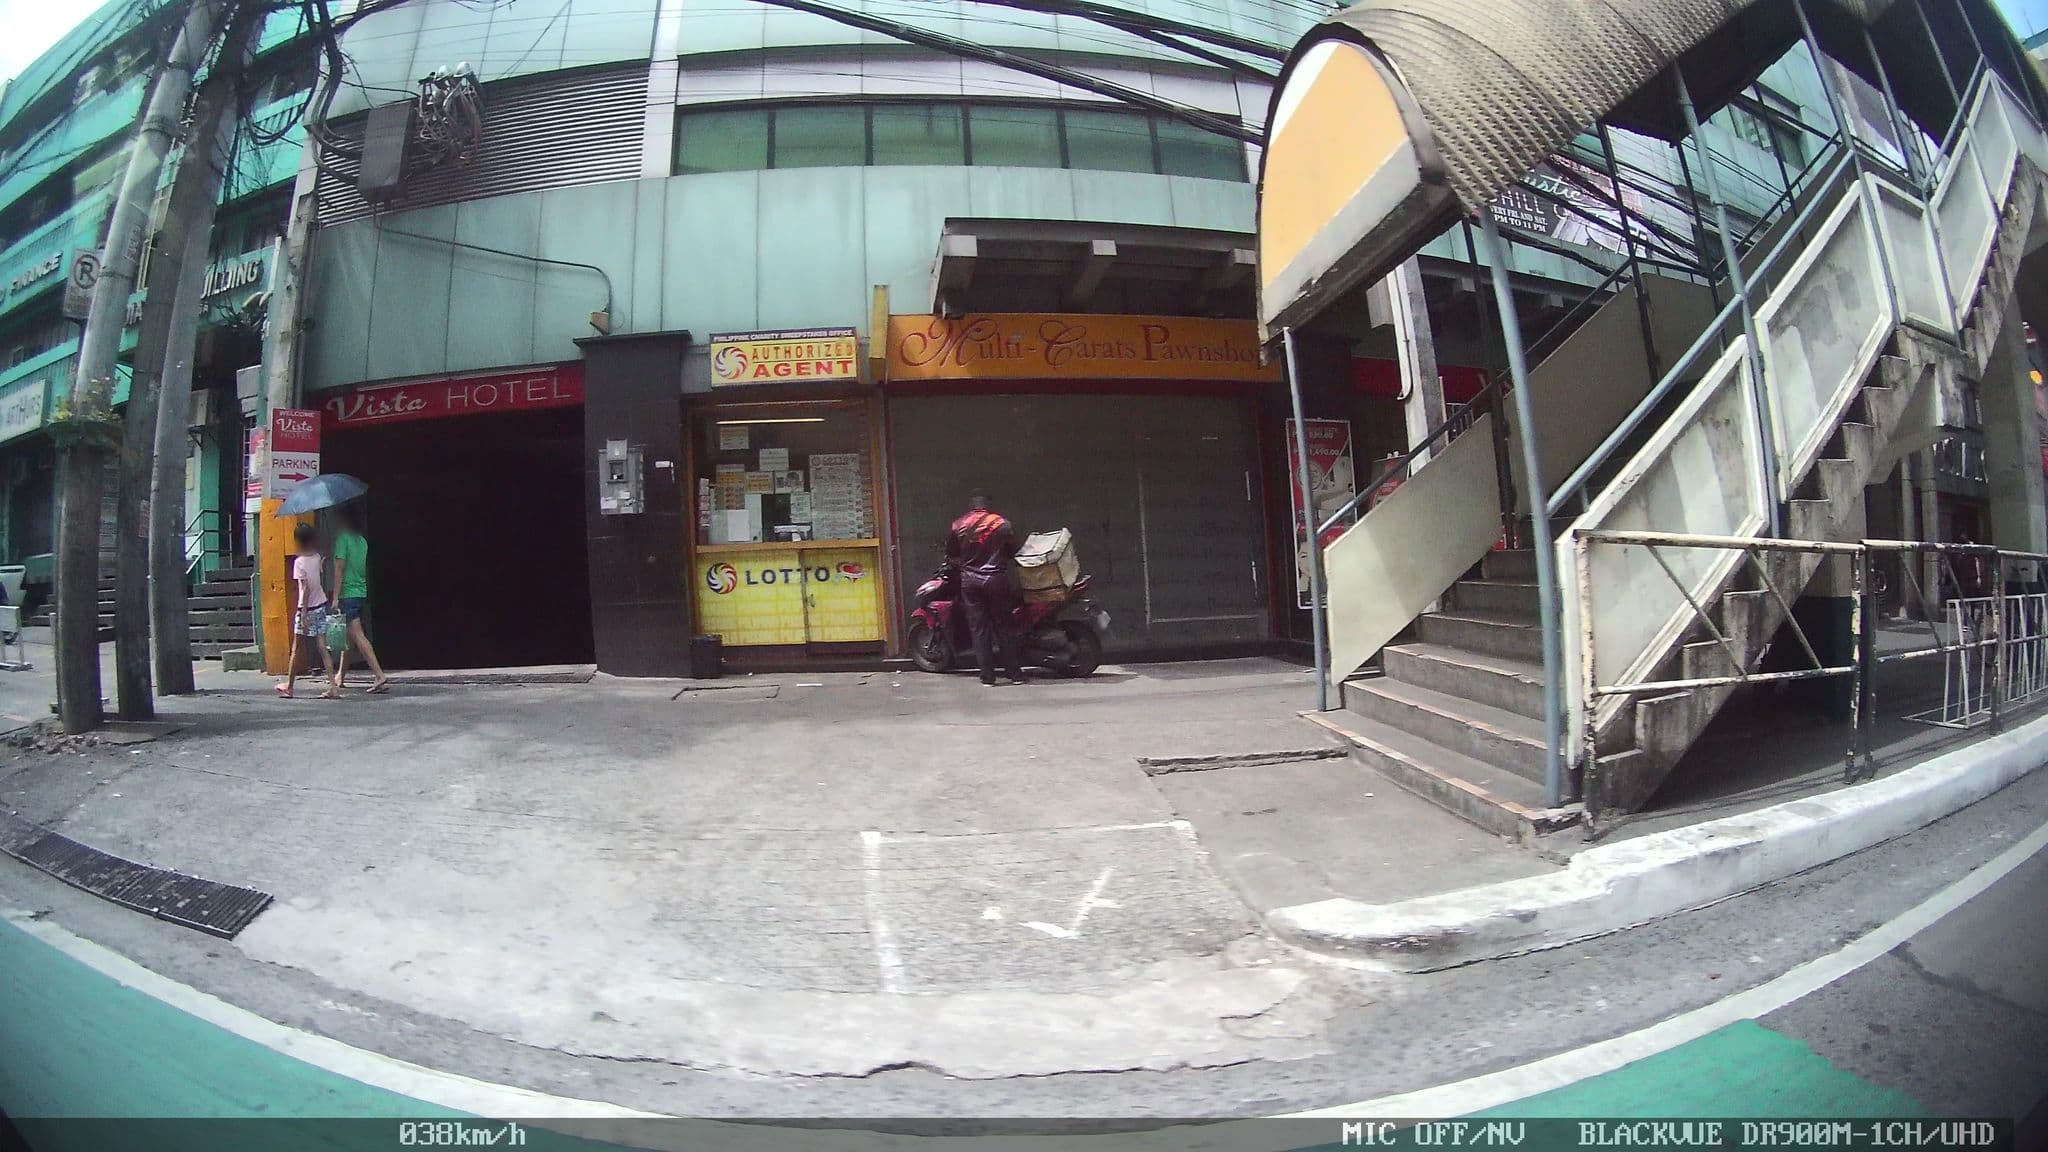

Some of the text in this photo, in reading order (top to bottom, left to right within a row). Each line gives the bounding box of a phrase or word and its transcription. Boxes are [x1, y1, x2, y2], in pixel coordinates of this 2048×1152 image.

[1490, 190, 1544, 215] HILL
[1521, 212, 1533, 222] AND
[1508, 218, 1521, 226] TO
[1523, 221, 1532, 229] 11
[1533, 223, 1546, 233] PM
[750, 332, 779, 340] CHARITY
[828, 329, 853, 337] OFFICE
[752, 342, 853, 360] AUTHORIZED
[1138, 323, 1259, 364] Pawnsho
[753, 360, 853, 378] AGENT
[326, 376, 571, 422] Vista HOTEL
[280, 410, 315, 418] WELCOME
[275, 418, 313, 432] Vista
[272, 458, 318, 470] PARKING
[746, 567, 830, 585] LOTTO
